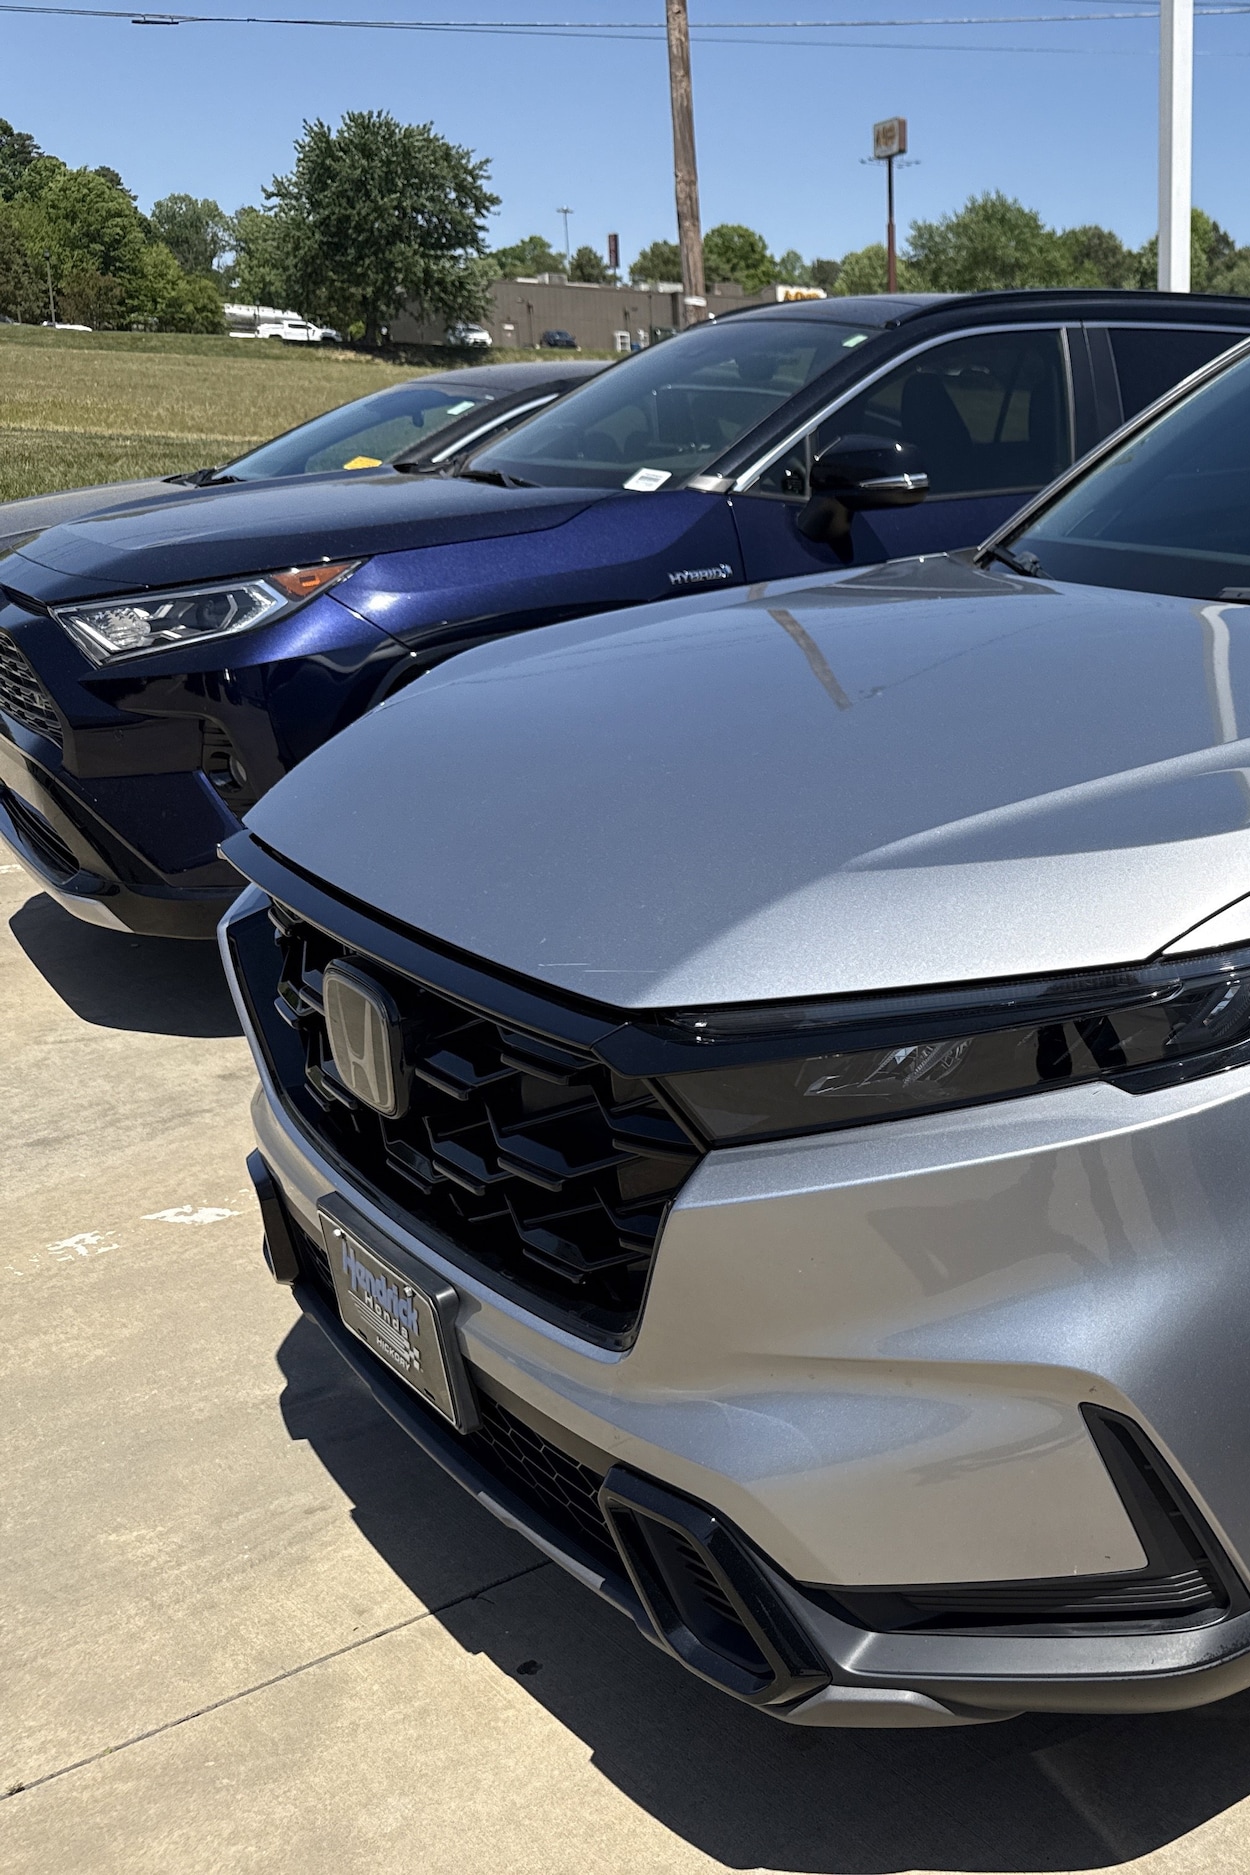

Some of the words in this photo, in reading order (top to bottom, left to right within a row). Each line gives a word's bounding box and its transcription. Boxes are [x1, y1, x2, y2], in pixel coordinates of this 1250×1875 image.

[668, 566, 724, 585] HYBRID
[342, 1239, 419, 1337] Hendrick
[364, 1290, 409, 1339] Honda
[376, 1336, 411, 1372] HICKORY
